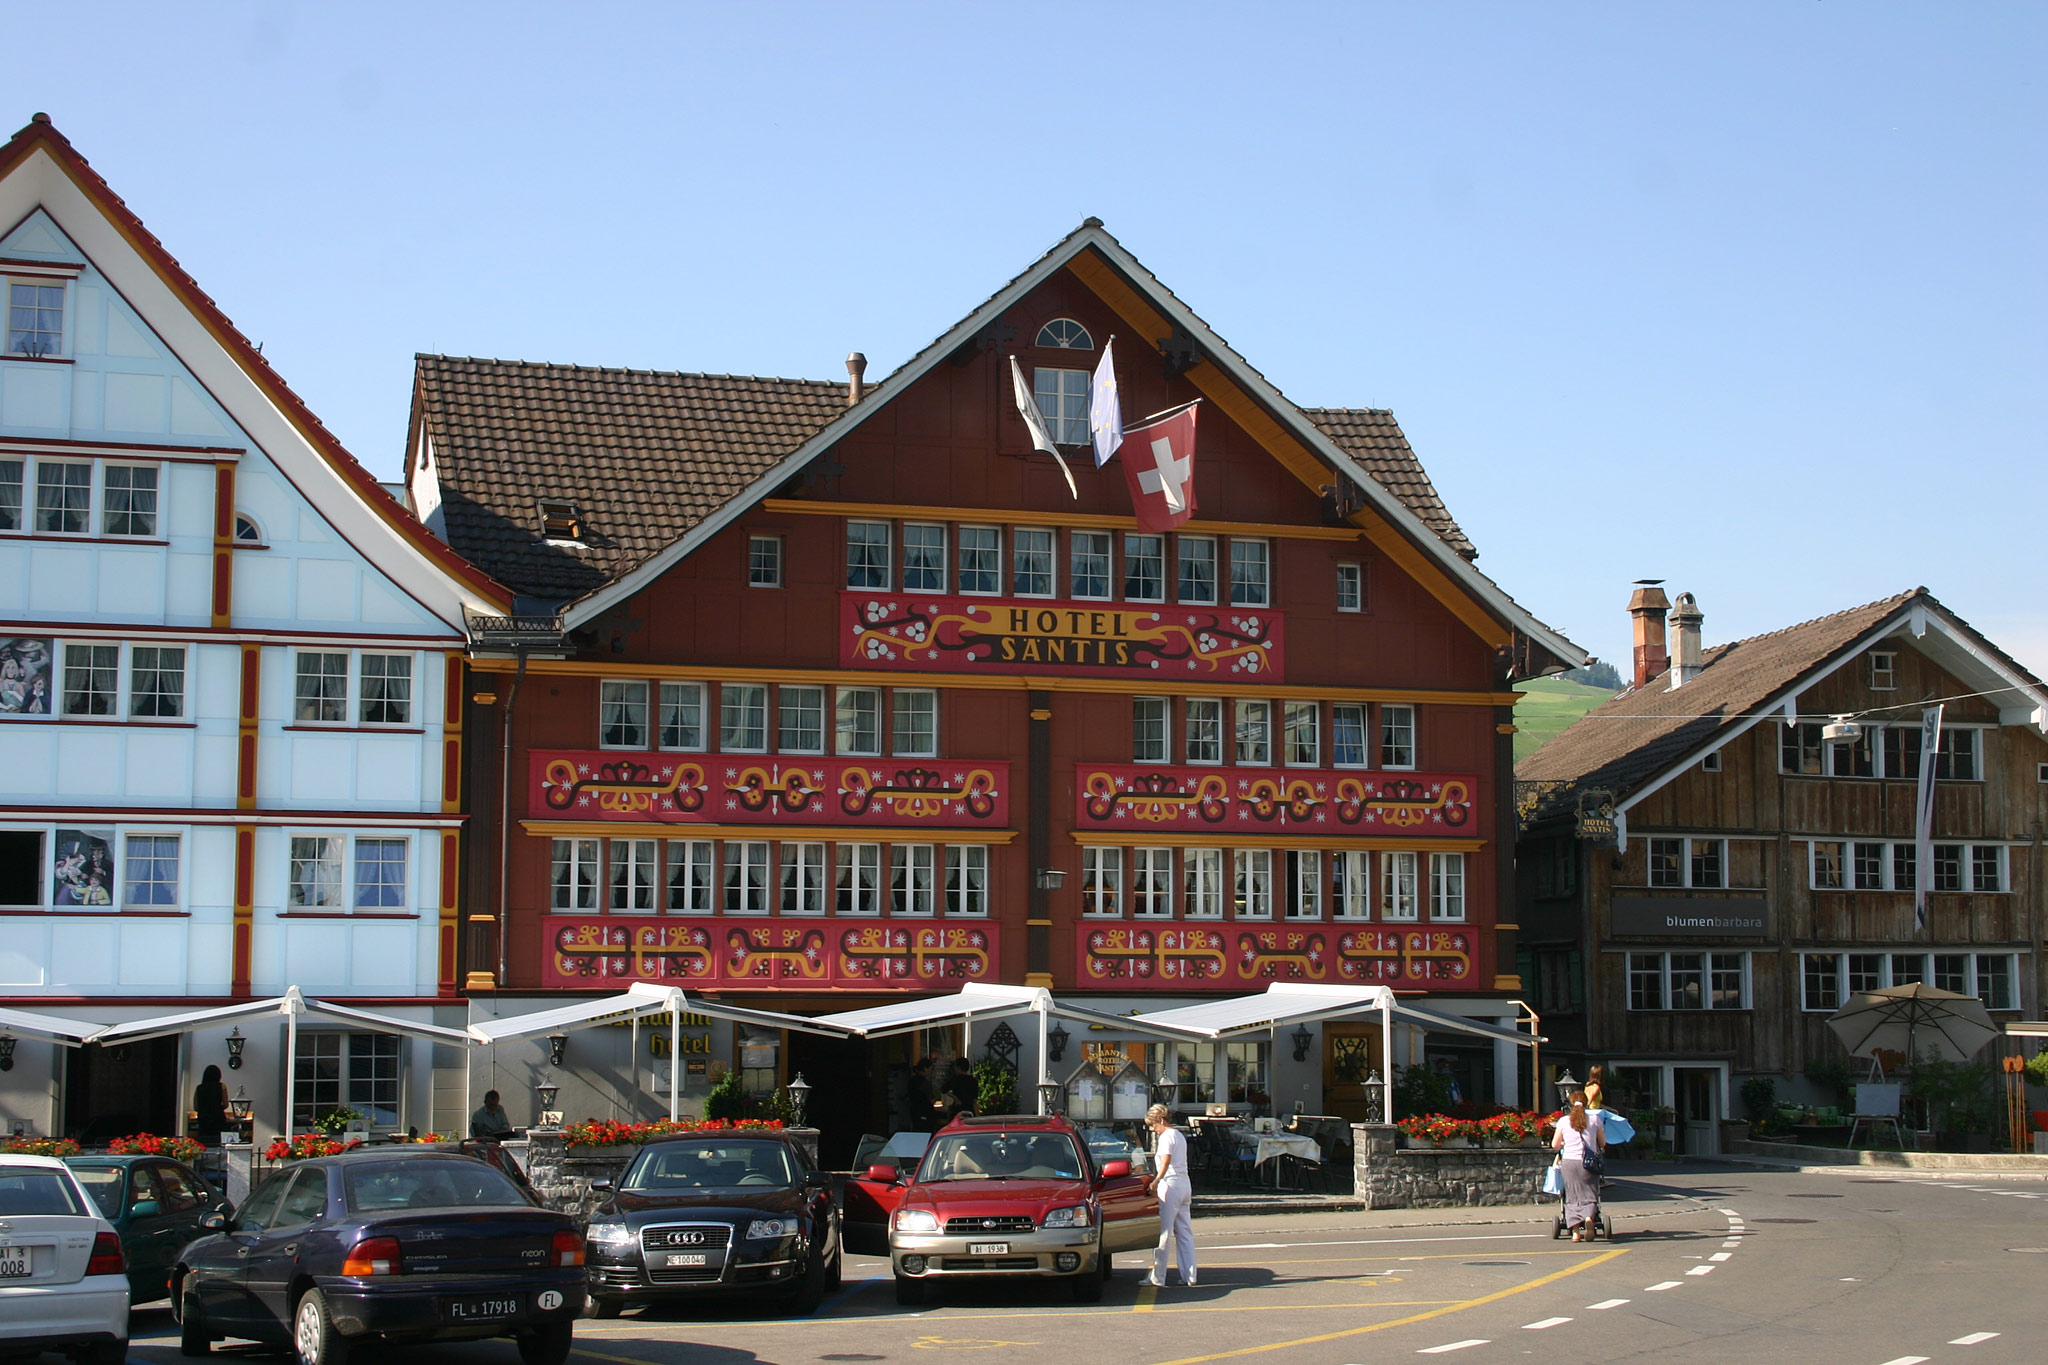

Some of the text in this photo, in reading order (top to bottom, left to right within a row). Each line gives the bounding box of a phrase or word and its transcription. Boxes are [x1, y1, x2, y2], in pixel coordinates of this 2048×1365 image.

[1009, 608, 1128, 636] HOTEL
[1001, 636, 1129, 665] SÄNTIS
[1666, 915, 1762, 927] blumenbarbara
[452, 1300, 517, 1316] FL 17918
[545, 1293, 555, 1307] FL
